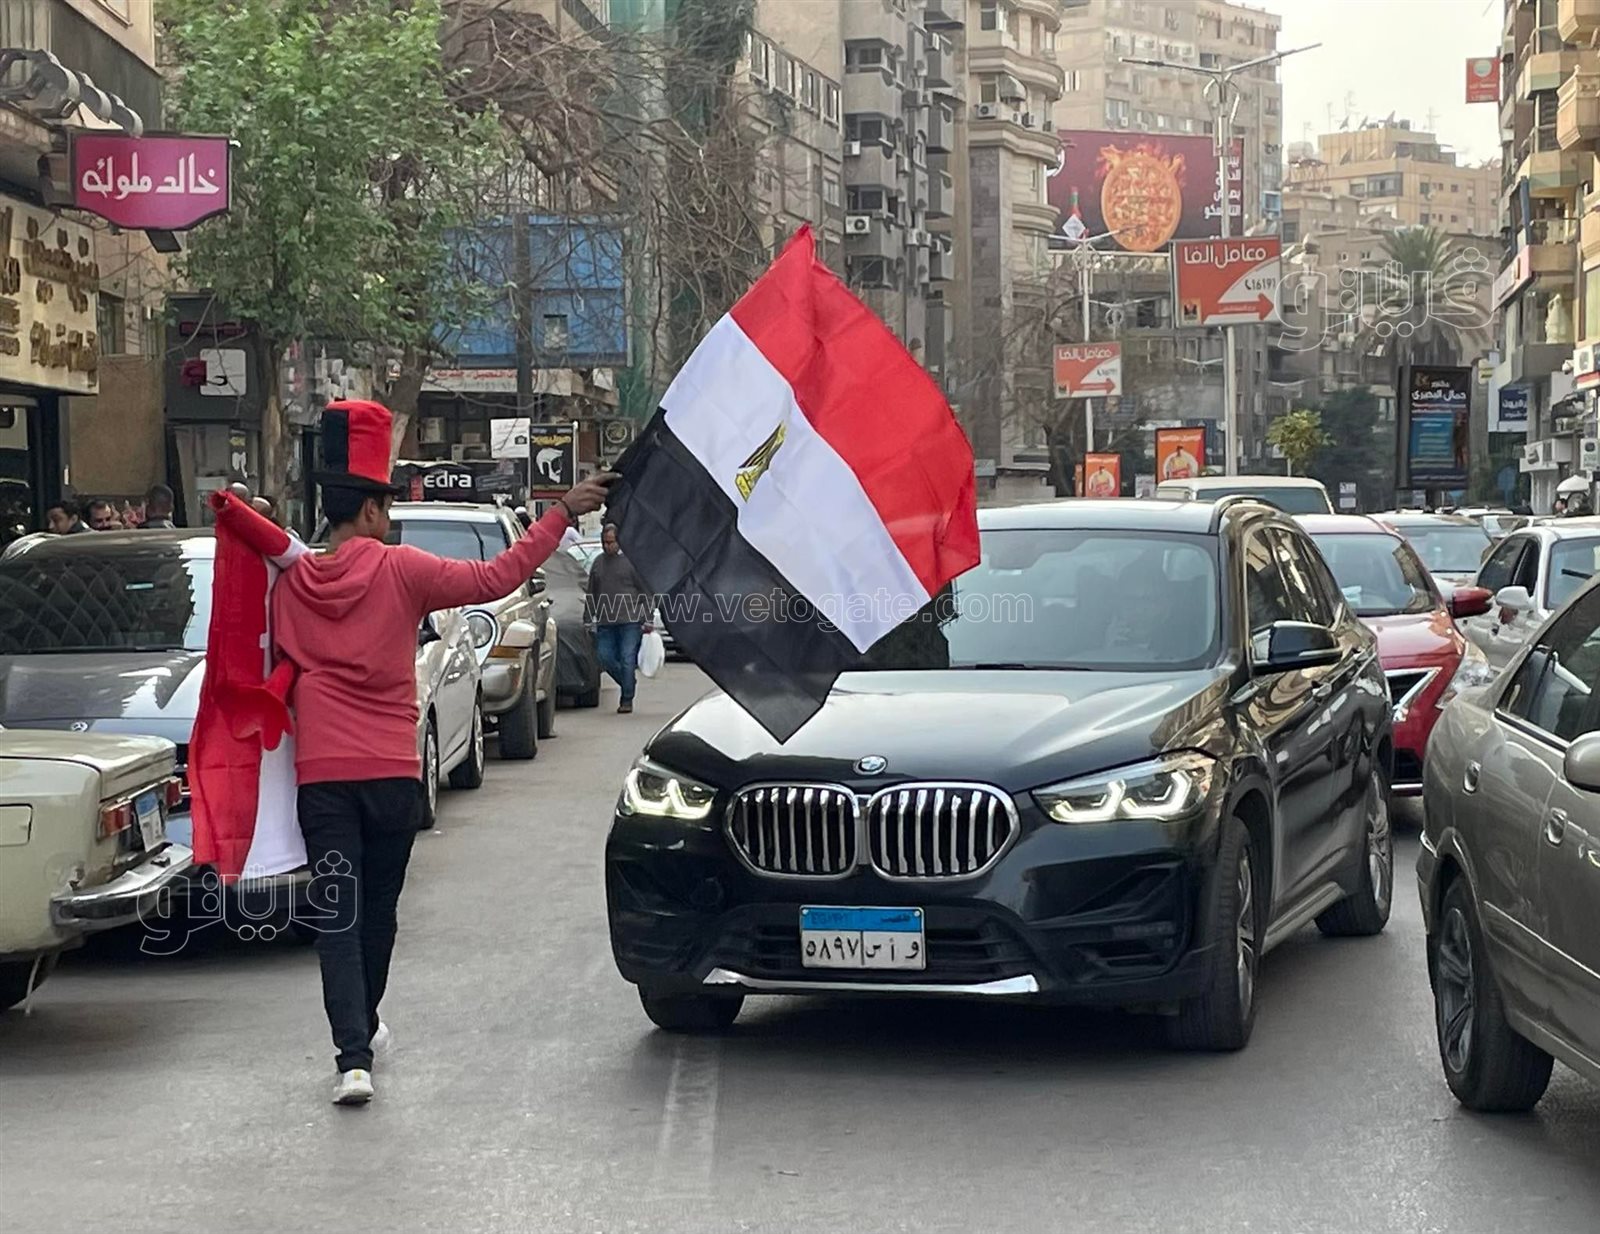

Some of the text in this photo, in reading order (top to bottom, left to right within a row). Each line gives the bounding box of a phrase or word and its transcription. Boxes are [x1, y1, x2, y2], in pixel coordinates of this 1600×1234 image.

[155, 152, 220, 194] خالد
[1215, 243, 1267, 269] معامل
[423, 470, 472, 488] edra
[805, 936, 859, 960] ٥٨٩٧
